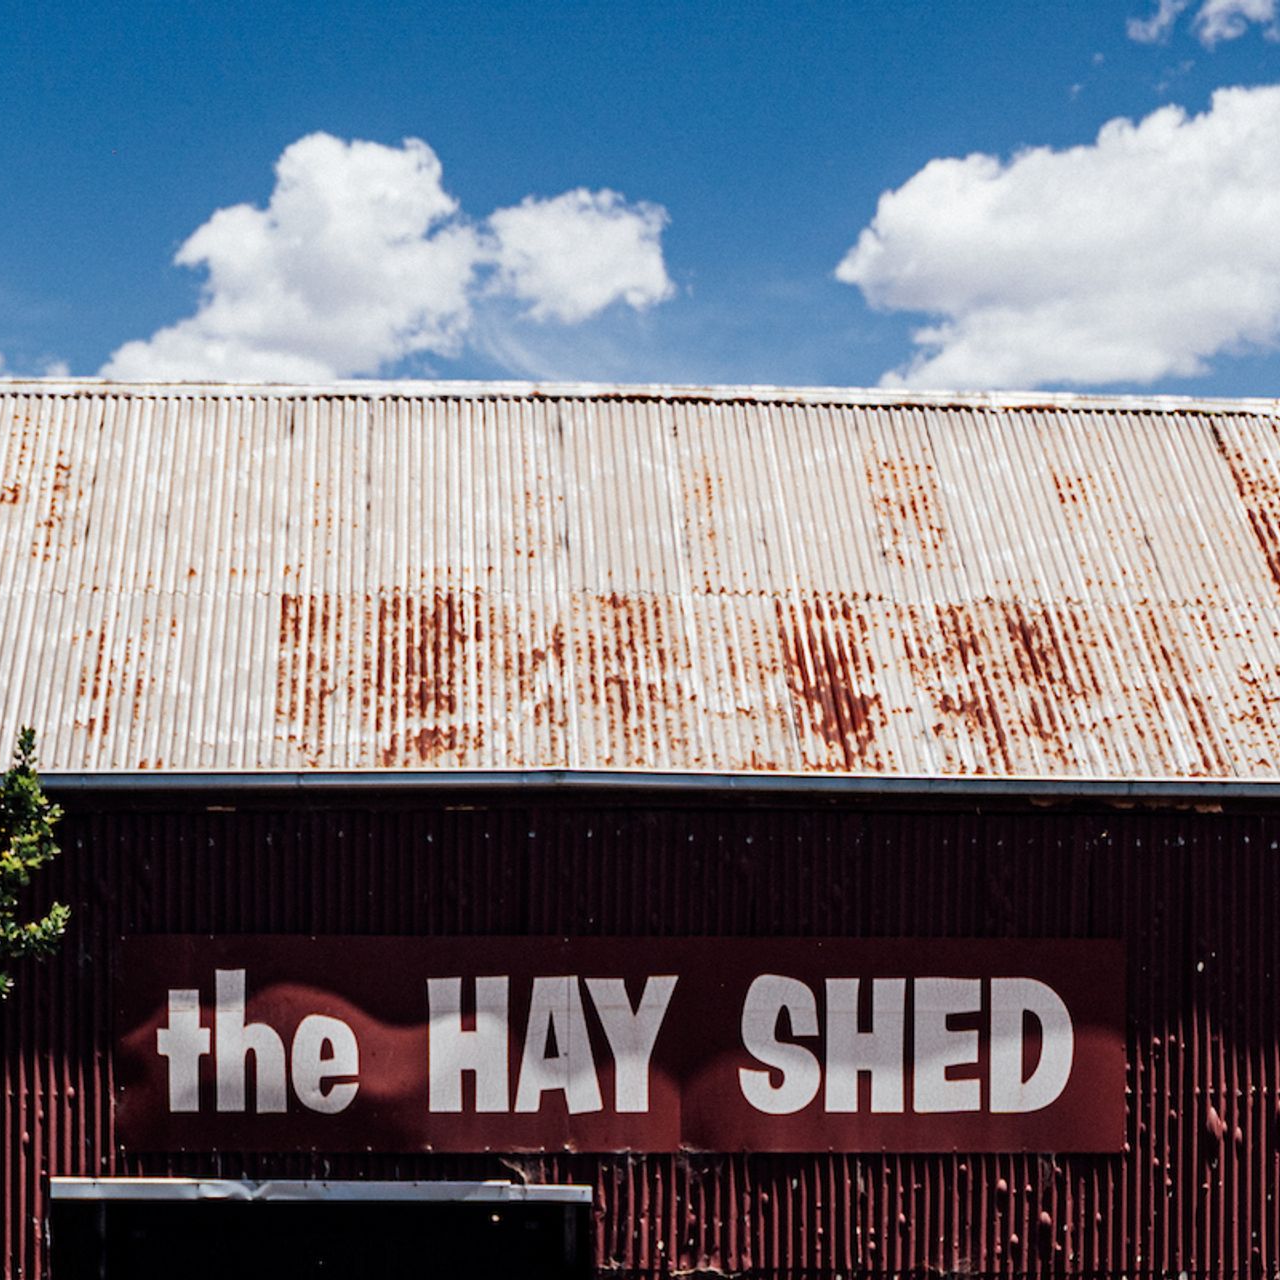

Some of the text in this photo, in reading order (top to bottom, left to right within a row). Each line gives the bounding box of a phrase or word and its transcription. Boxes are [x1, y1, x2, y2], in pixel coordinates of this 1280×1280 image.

[156, 968, 1075, 1115] the HAY SHED
